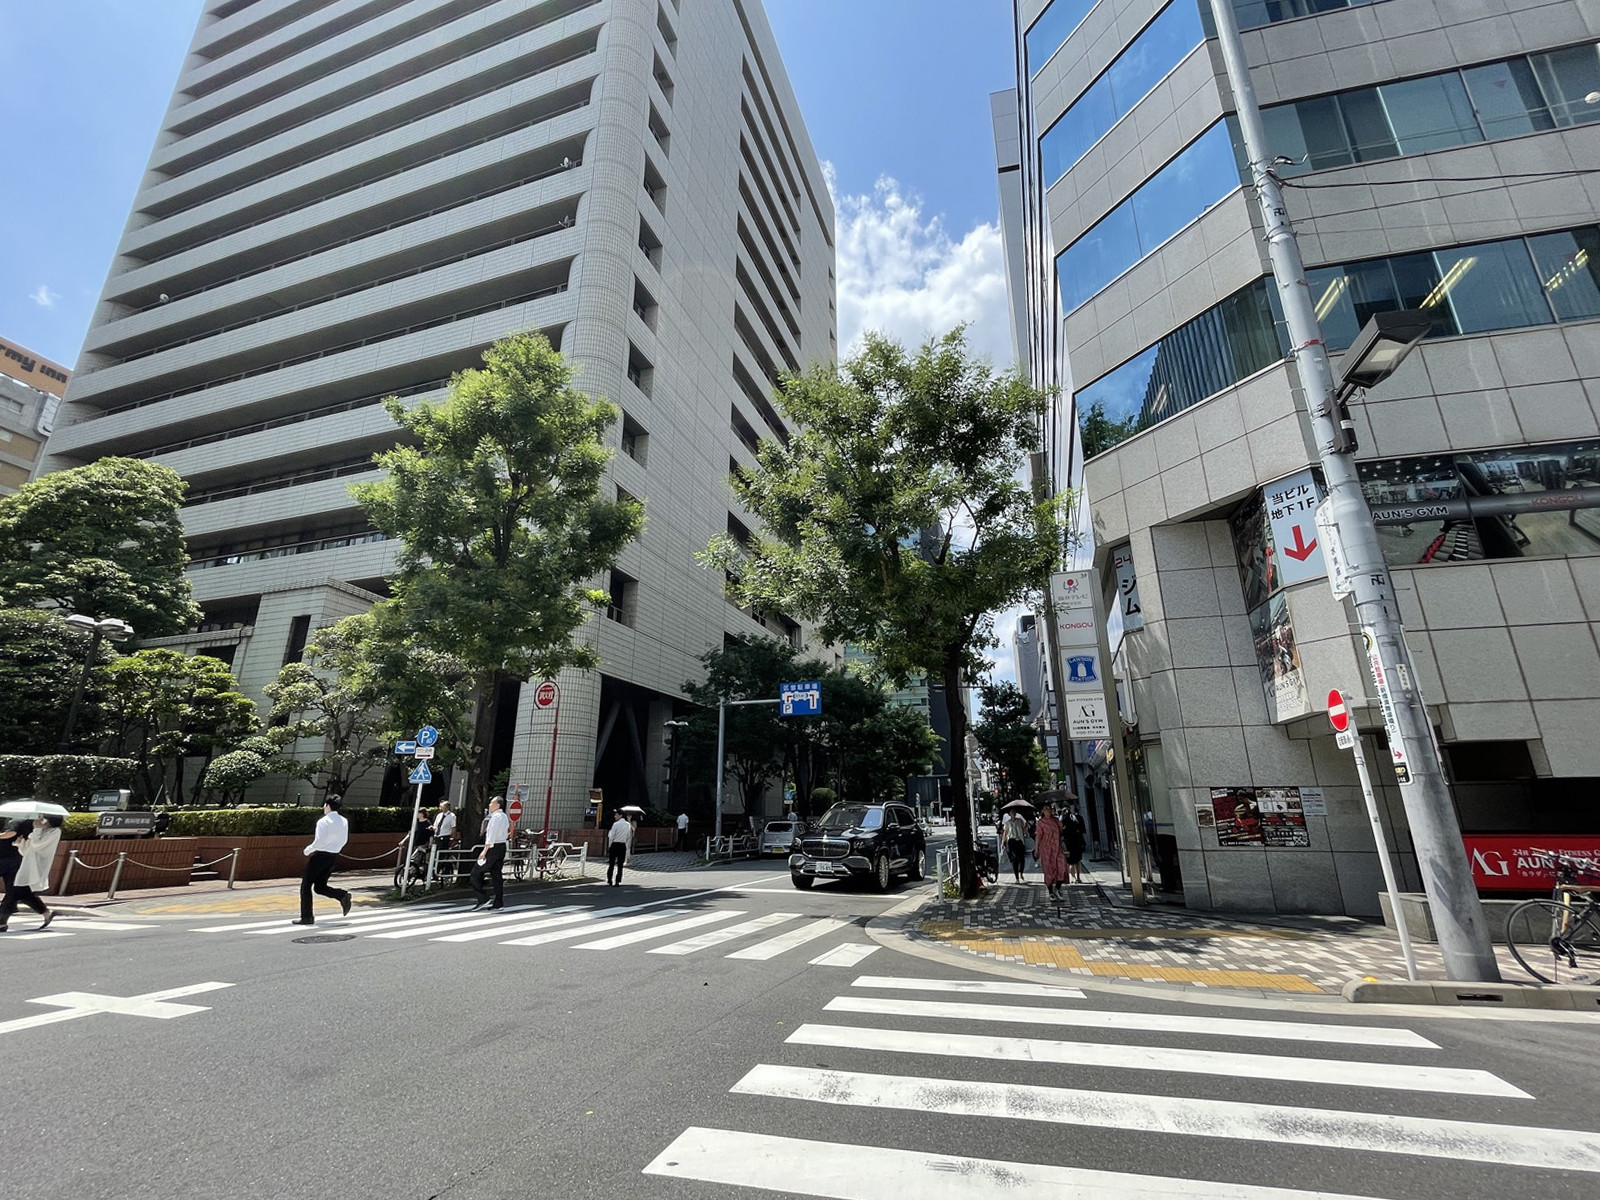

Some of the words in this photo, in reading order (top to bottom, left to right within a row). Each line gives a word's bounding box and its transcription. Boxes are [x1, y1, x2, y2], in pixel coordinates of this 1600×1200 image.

[40, 364, 68, 383] inn
[1272, 485, 1309, 505] 当ビル
[1271, 497, 1315, 520] 地下1F
[1372, 508, 1413, 521] AUN'S
[1416, 505, 1449, 517] GYM
[1122, 574, 1142, 616] ジム
[1060, 621, 1094, 630] KONGOU
[785, 704, 792, 713] P
[421, 731, 429, 743] P
